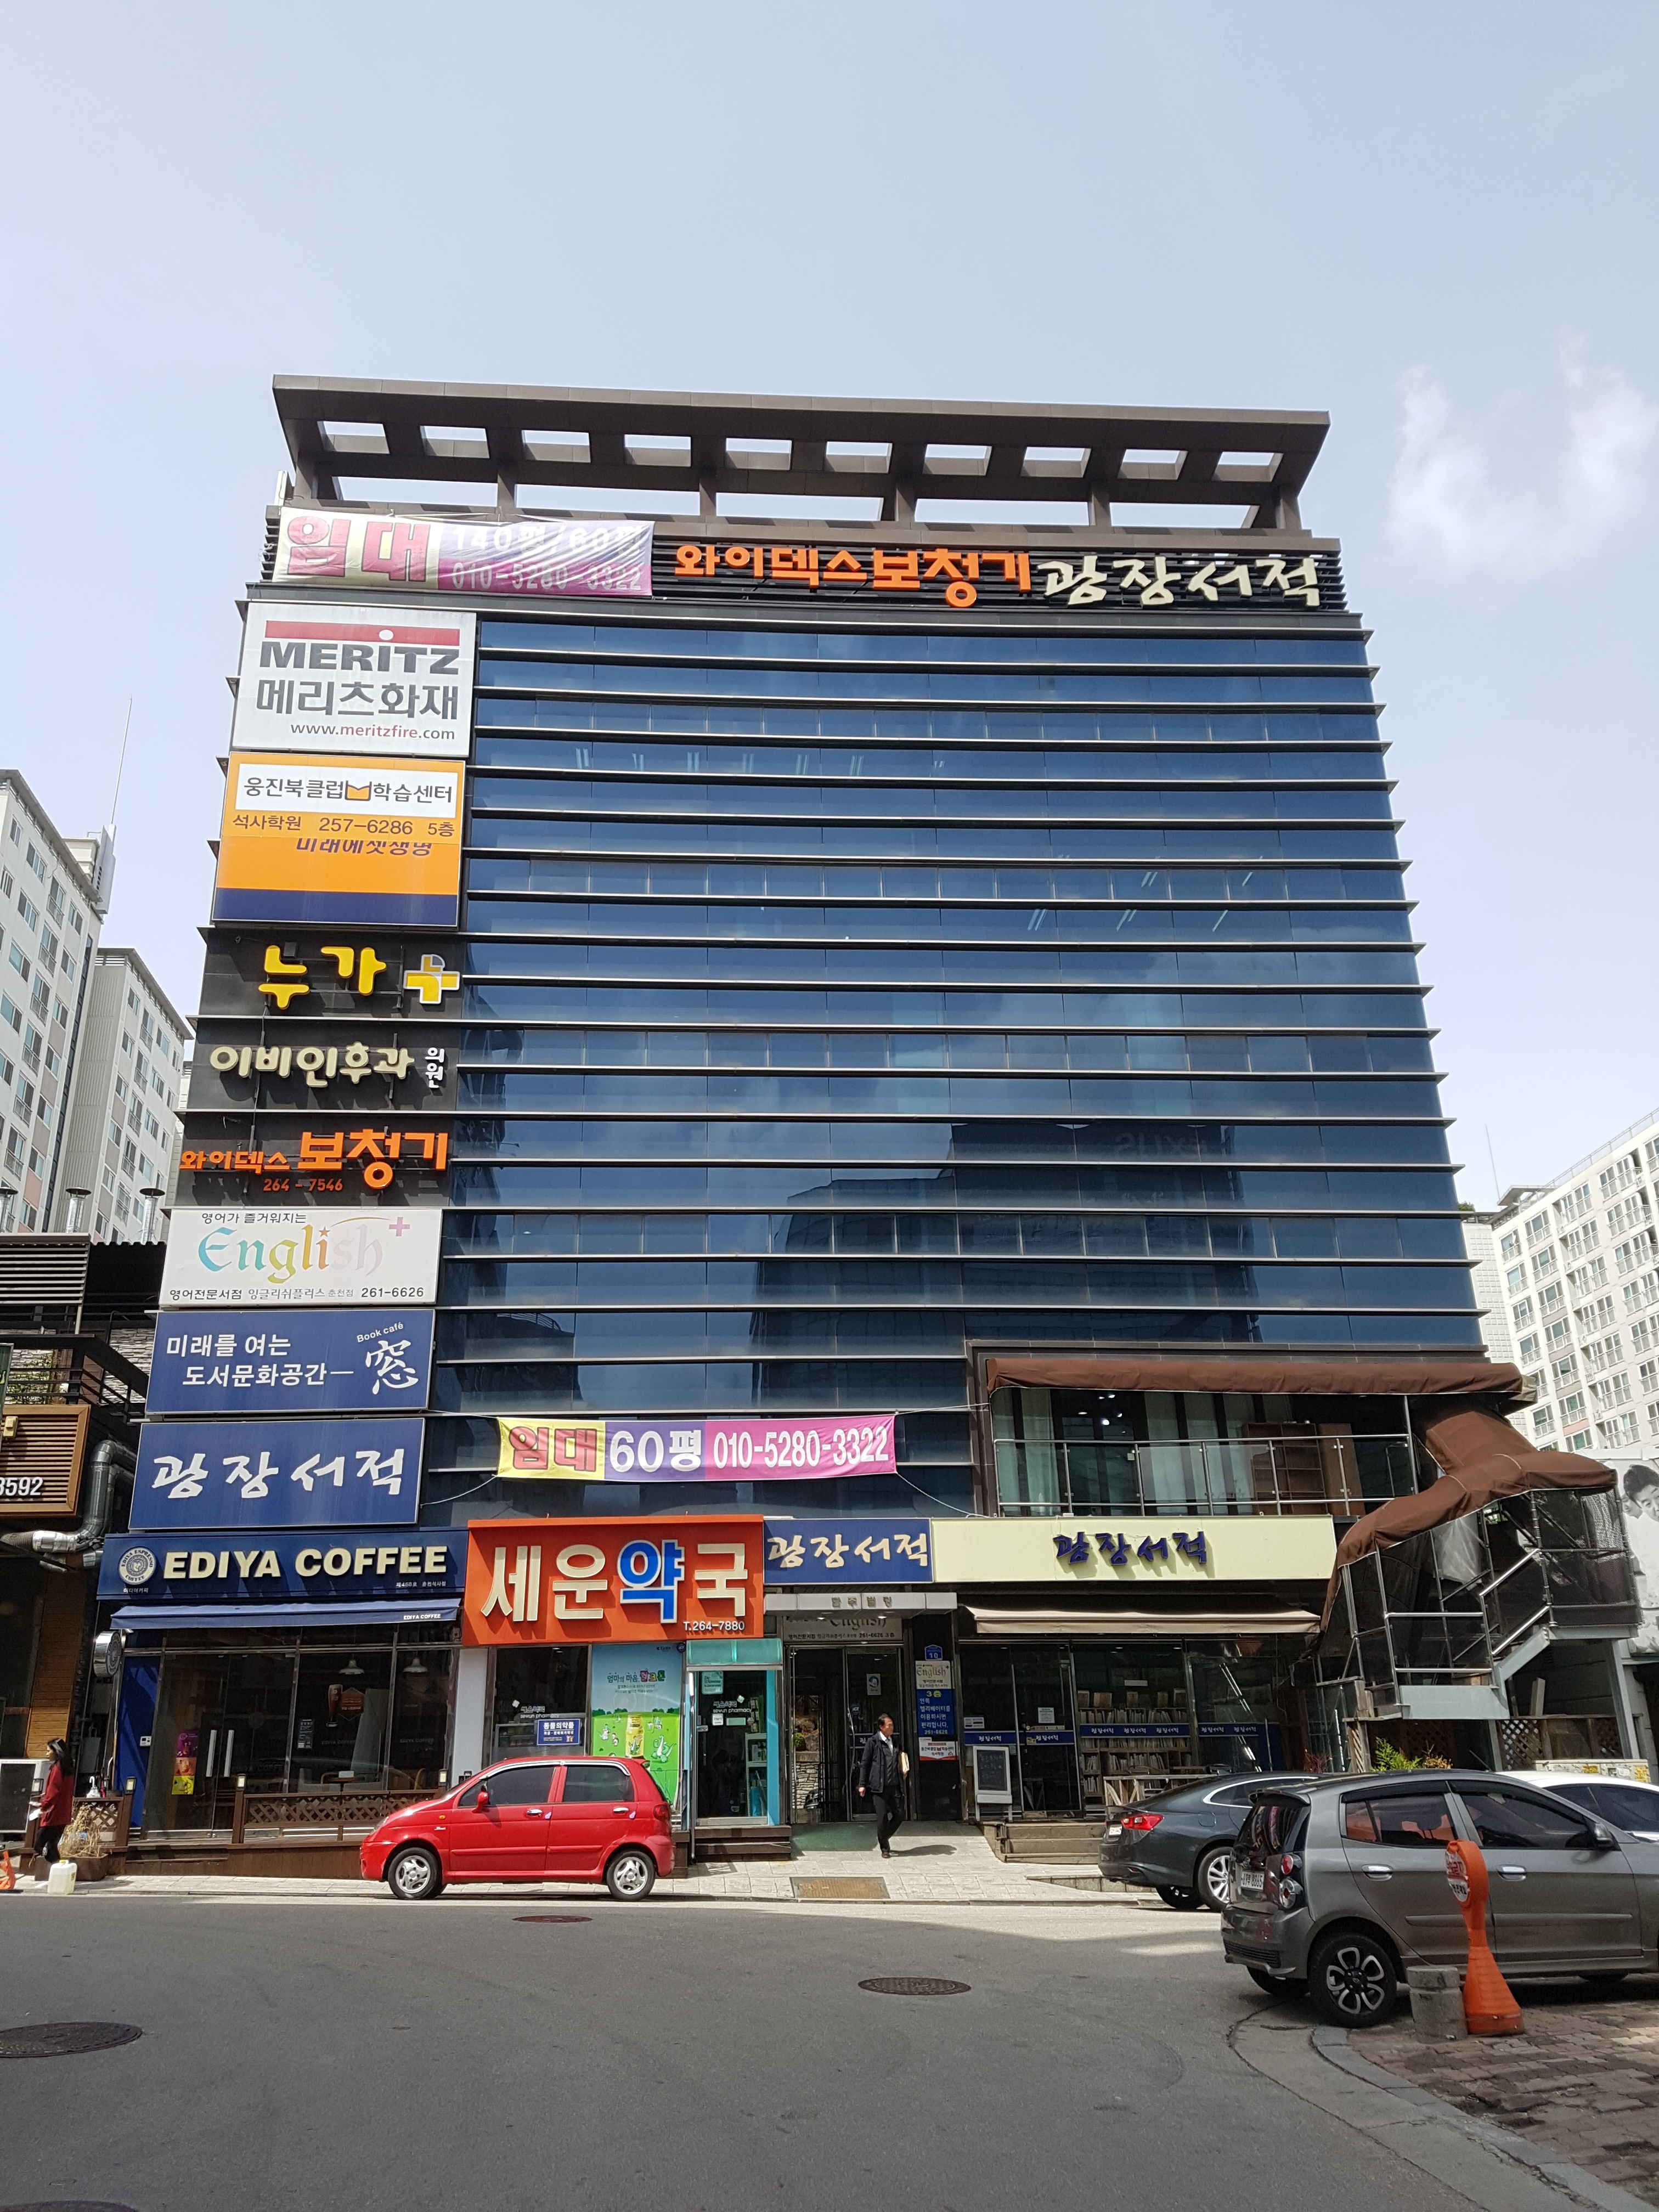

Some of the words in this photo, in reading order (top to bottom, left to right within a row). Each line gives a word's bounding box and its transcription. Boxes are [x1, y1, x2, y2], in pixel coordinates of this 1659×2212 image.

[287, 516, 430, 582] 임대
[452, 562, 641, 590] 010-5280-3322
[1037, 555, 1319, 606] 광장서적
[259, 641, 459, 675] MERITZ
[256, 680, 458, 719] 메리츠화재
[291, 724, 455, 740] www.meritzfire.com
[244, 777, 344, 799] 웅진북클럽
[373, 782, 452, 803] 학습센터
[233, 815, 301, 831] 석사학원
[319, 817, 413, 835] 257-6286
[427, 822, 455, 837] 5층
[258, 945, 386, 1009] 누가
[210, 1041, 415, 1087] 이비인후과
[425, 1047, 444, 1088] 의원
[179, 1151, 290, 1175] 와이덱스
[298, 1128, 448, 1188] 보청기
[202, 1213, 239, 1224] 영어가
[244, 1213, 306, 1223] 즐거워지는
[199, 1224, 383, 1284] English
[170, 1289, 242, 1300] 영어전문서점
[248, 1288, 325, 1300] 잉글리쉬플러스
[328, 1289, 354, 1298] 춘천점
[362, 1287, 424, 1298] 261-6626
[167, 1334, 237, 1357] 미래를
[245, 1334, 291, 1356] 여는
[357, 1329, 382, 1342] Book
[383, 1322, 404, 1334] café
[183, 1363, 326, 1387] 도서문화공간
[509, 1426, 597, 1471] 임대
[611, 1429, 702, 1472] 60평
[713, 1426, 889, 1470] 010-5280-3322
[152, 1448, 404, 1499] 광장서적
[163, 1550, 281, 1579] EDIYA
[295, 1545, 448, 1577] COFFEE
[768, 1533, 928, 1568] 광장서적
[1053, 1531, 1207, 1565] 광장서적
[481, 1539, 748, 1624] 세운약국
[683, 1621, 745, 1632] T.264-7880
[917, 1667, 946, 1678] English
